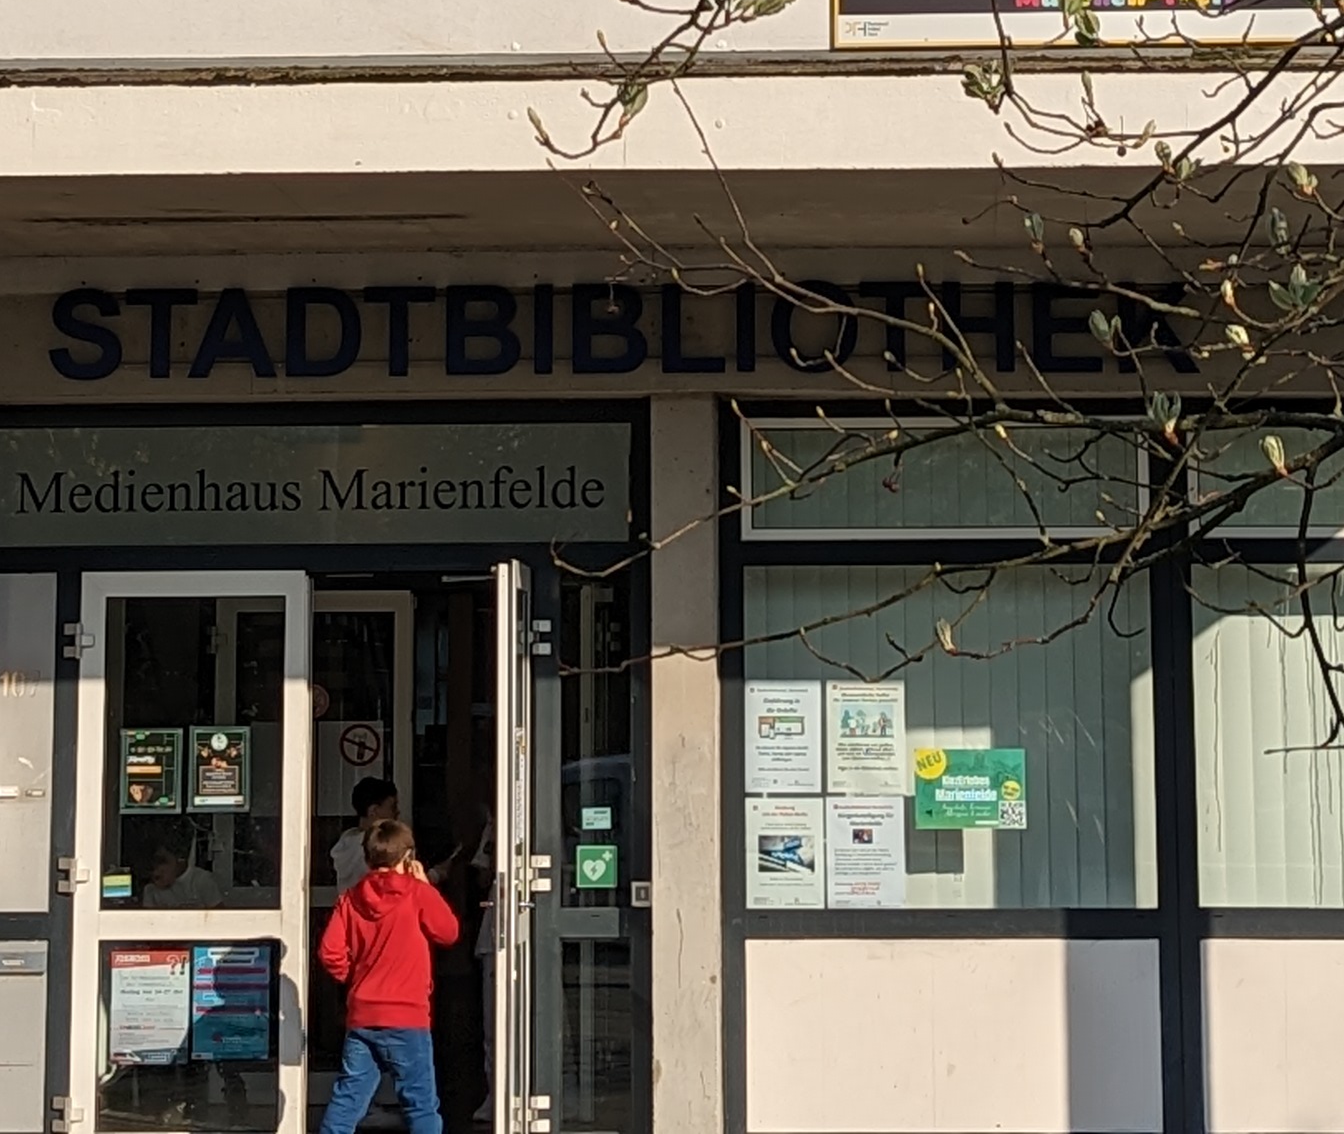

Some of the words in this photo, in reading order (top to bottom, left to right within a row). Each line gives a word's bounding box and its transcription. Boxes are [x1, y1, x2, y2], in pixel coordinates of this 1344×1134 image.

[48, 279, 1201, 382] STADTBIBLIOTHEK
[16, 469, 302, 514] Medienhaus
[319, 465, 605, 511] Marienfelde
[0, 670, 41, 698] 107
[916, 751, 942, 772] NEU
